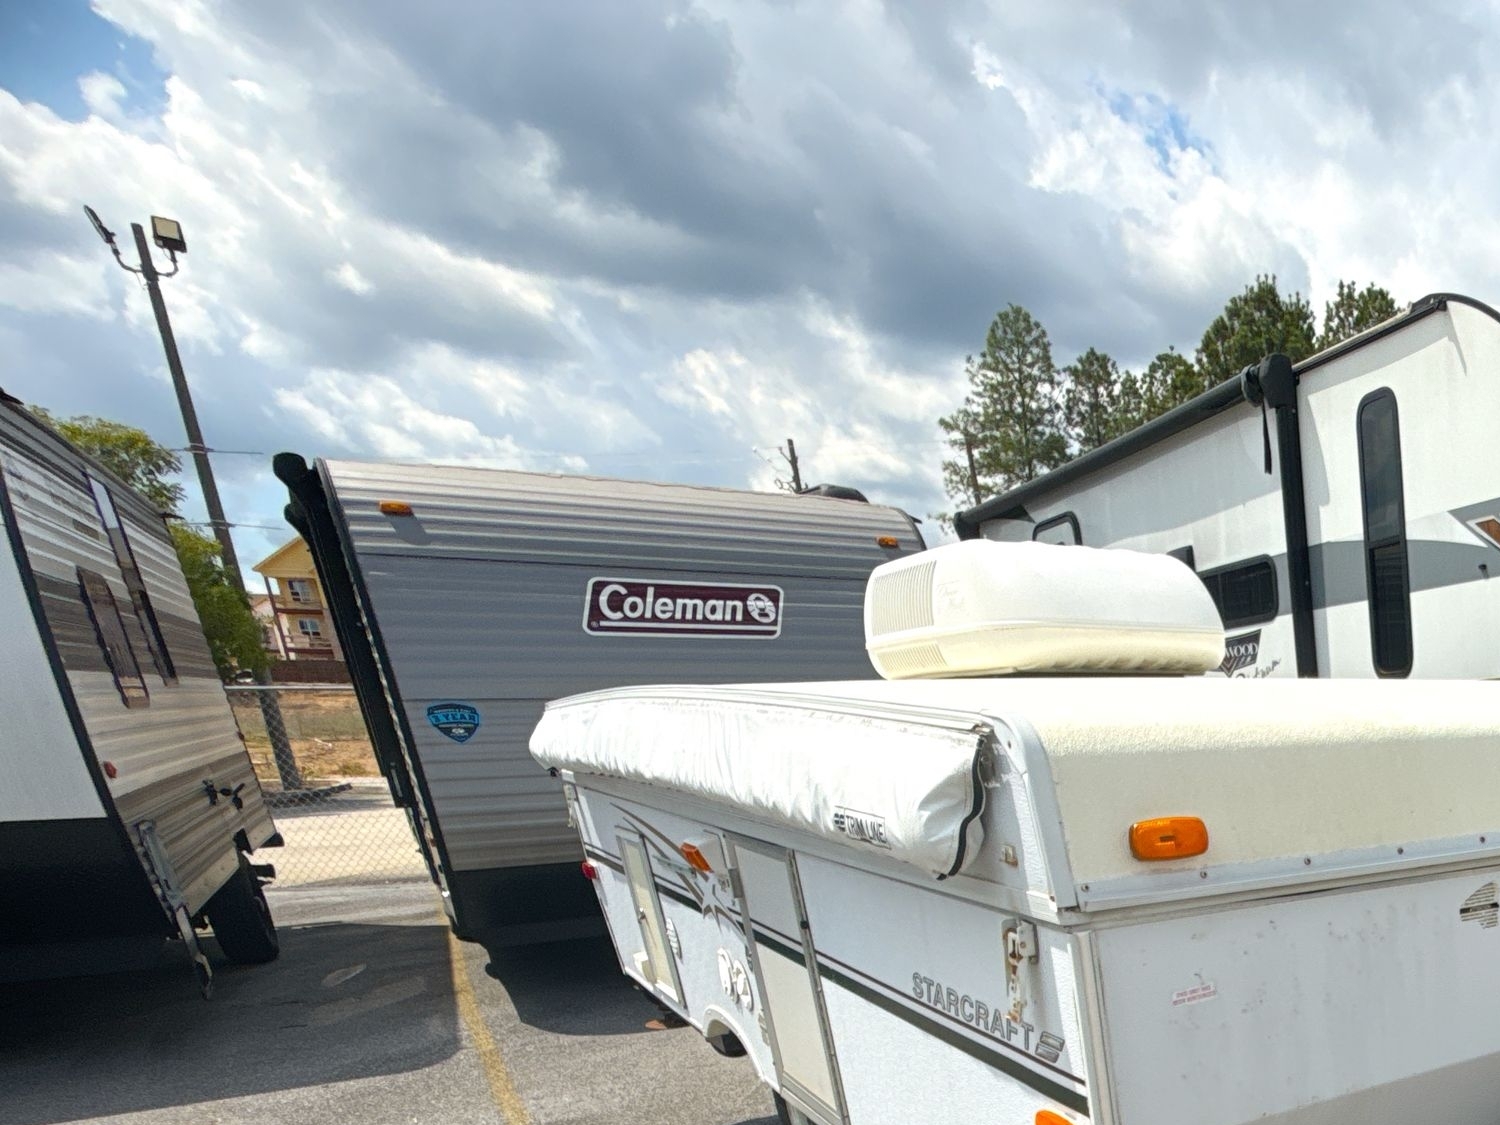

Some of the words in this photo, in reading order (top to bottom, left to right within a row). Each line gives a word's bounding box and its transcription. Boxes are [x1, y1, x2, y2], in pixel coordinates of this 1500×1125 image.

[598, 584, 744, 622] Coleman
[1225, 642, 1258, 658] WOOD
[846, 815, 868, 839] TRIM
[865, 819, 888, 844] LINE
[912, 971, 1034, 1051] STARCRAFT
